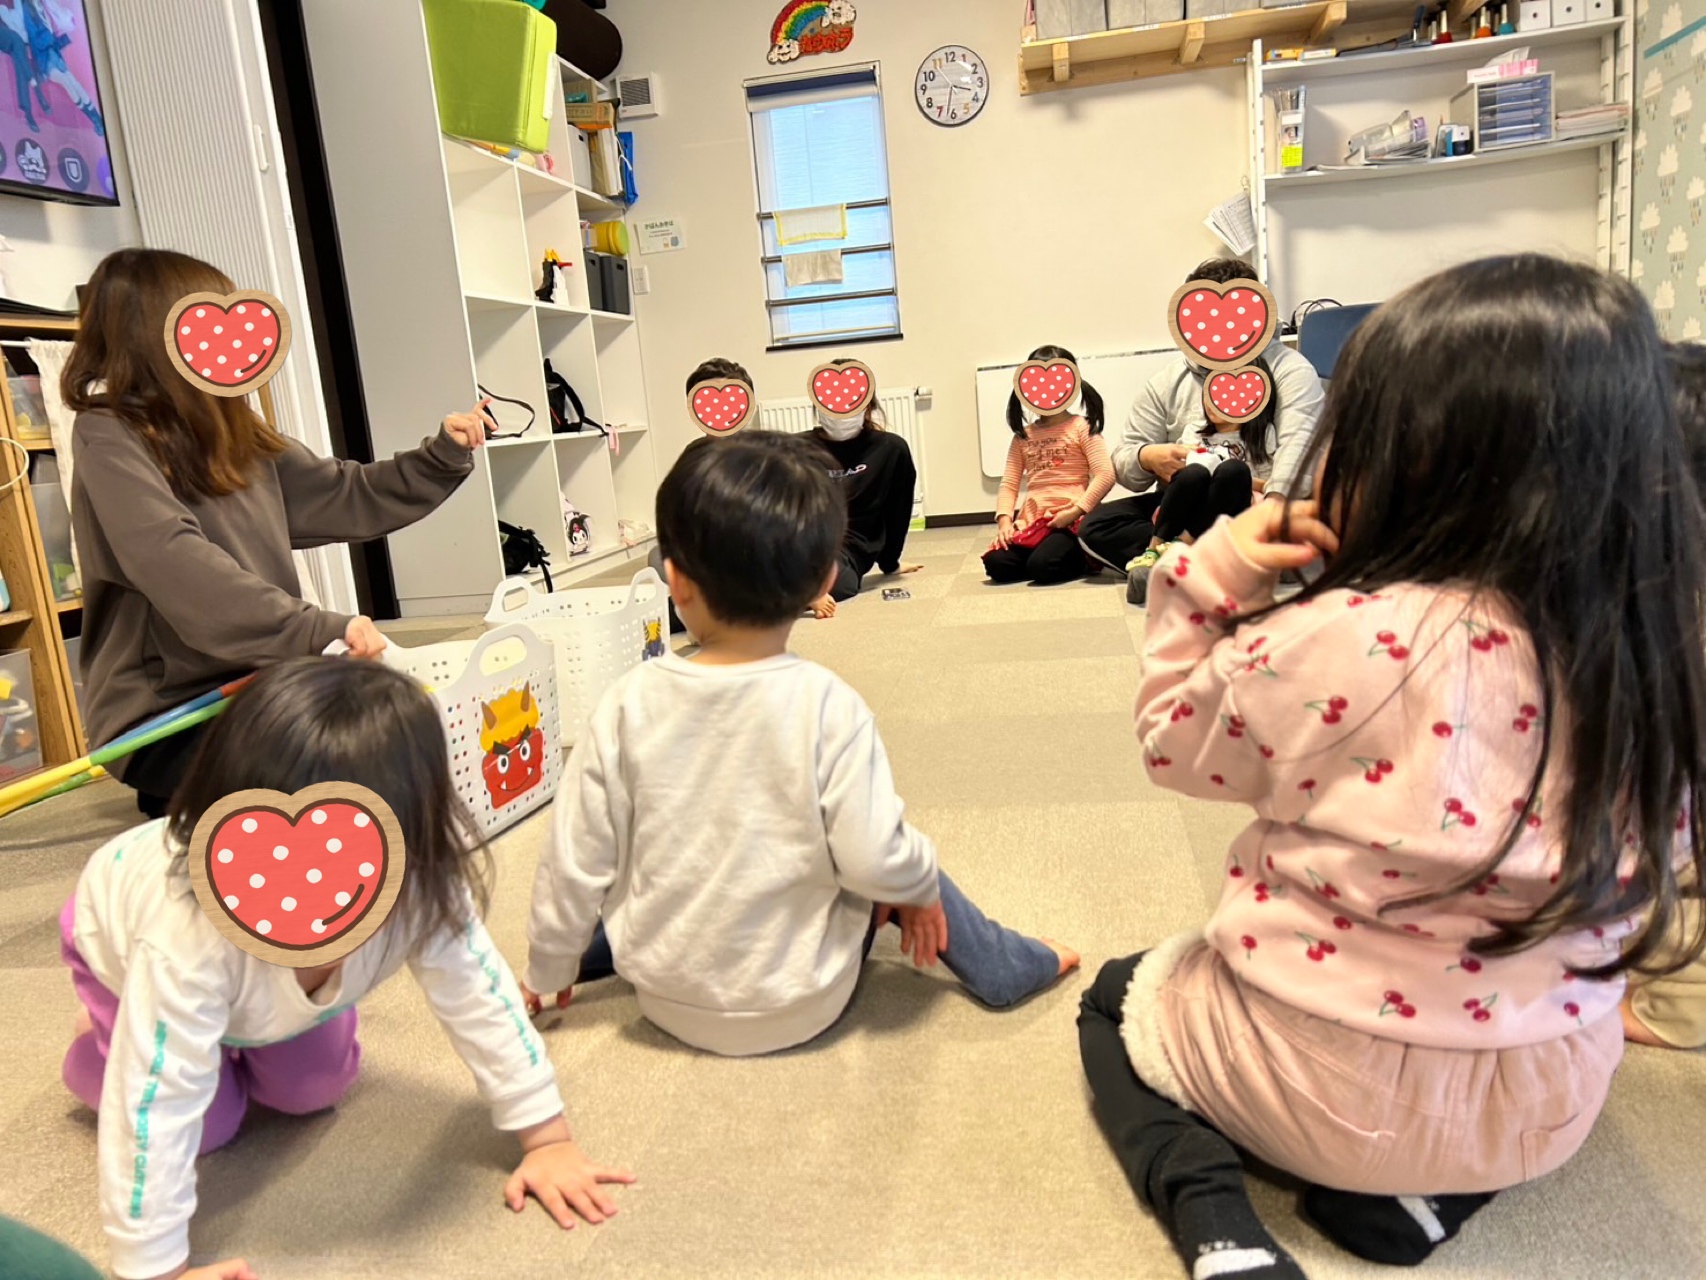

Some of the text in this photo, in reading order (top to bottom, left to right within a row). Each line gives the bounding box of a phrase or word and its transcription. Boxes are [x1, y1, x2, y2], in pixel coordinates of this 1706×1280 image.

[944, 51, 956, 63] 12
[961, 54, 967, 62] 1
[932, 58, 942, 69] 11
[971, 63, 978, 75] 2
[923, 70, 935, 82] 10
[976, 76, 984, 88] 3
[920, 83, 927, 95] 9
[926, 97, 933, 109] 8
[971, 91, 979, 103] 4
[936, 105, 943, 118] 7
[950, 108, 957, 120] 6
[963, 102, 970, 114] 5
